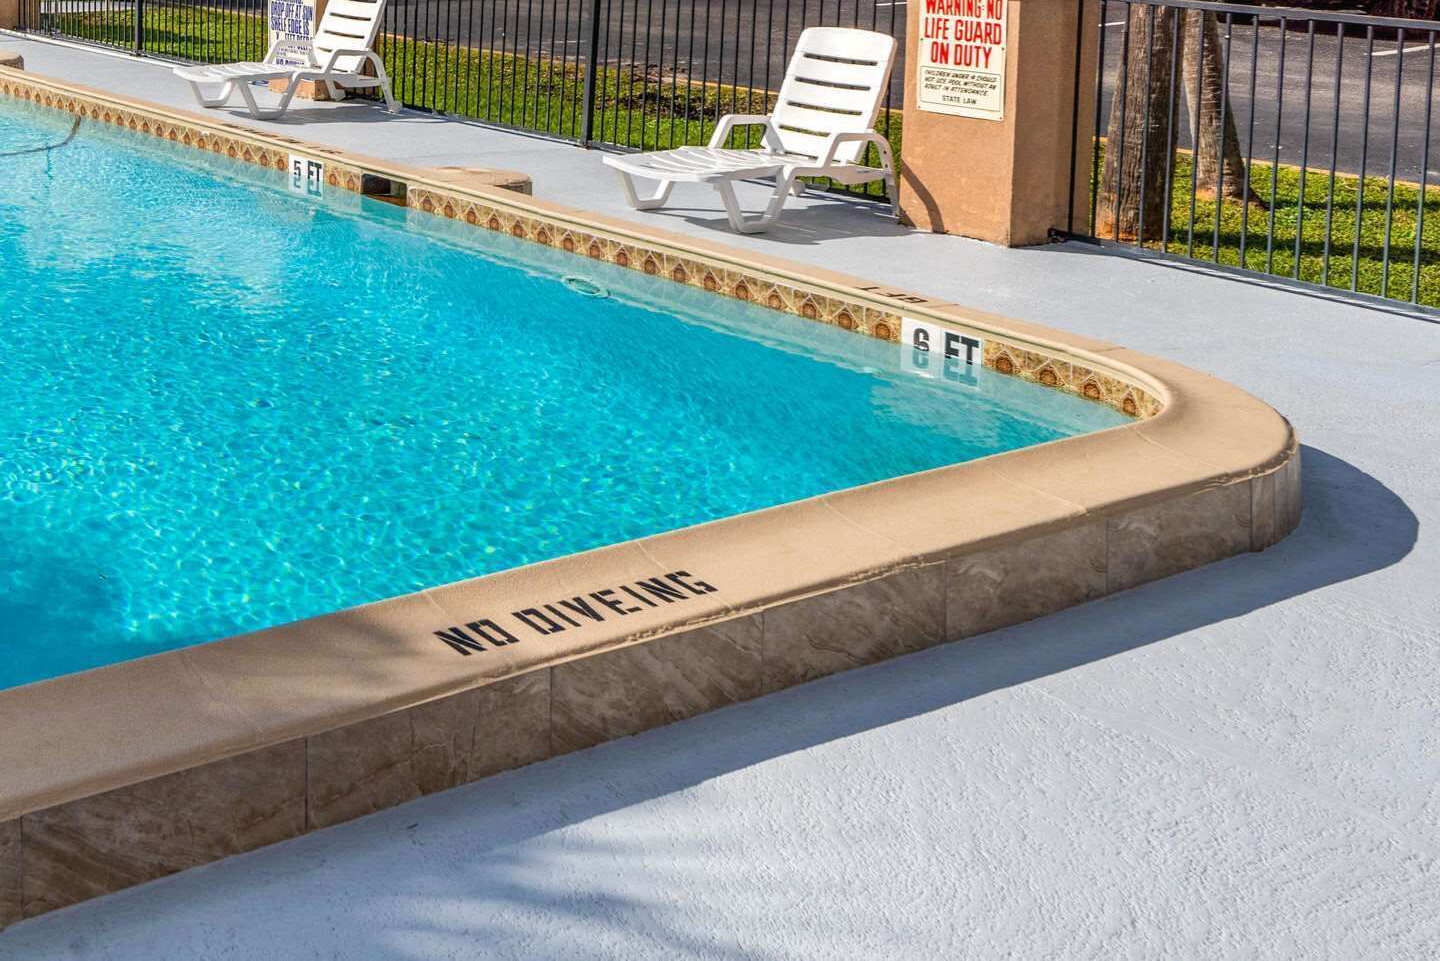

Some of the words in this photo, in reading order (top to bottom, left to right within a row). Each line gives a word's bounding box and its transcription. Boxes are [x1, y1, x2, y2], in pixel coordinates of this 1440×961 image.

[271, 1, 285, 17] DROP
[285, 3, 295, 19] OFF
[295, 4, 302, 20] AT
[271, 16, 287, 31] SHELF
[288, 19, 302, 34] EDGE
[303, 20, 310, 35] IS
[924, 17, 949, 40] LIFE
[954, 19, 1002, 45] GUARD
[930, 41, 949, 64] ON
[954, 44, 992, 69] DUTY
[963, 80, 989, 89] WITHOUT
[942, 95, 961, 103] STATE
[963, 97, 977, 105] LAW
[293, 160, 301, 177] 5
[307, 160, 322, 182] FT
[912, 327, 930, 352] 6
[944, 331, 980, 366] FT
[433, 619, 520, 656] NO
[511, 570, 719, 636] DIVEING
